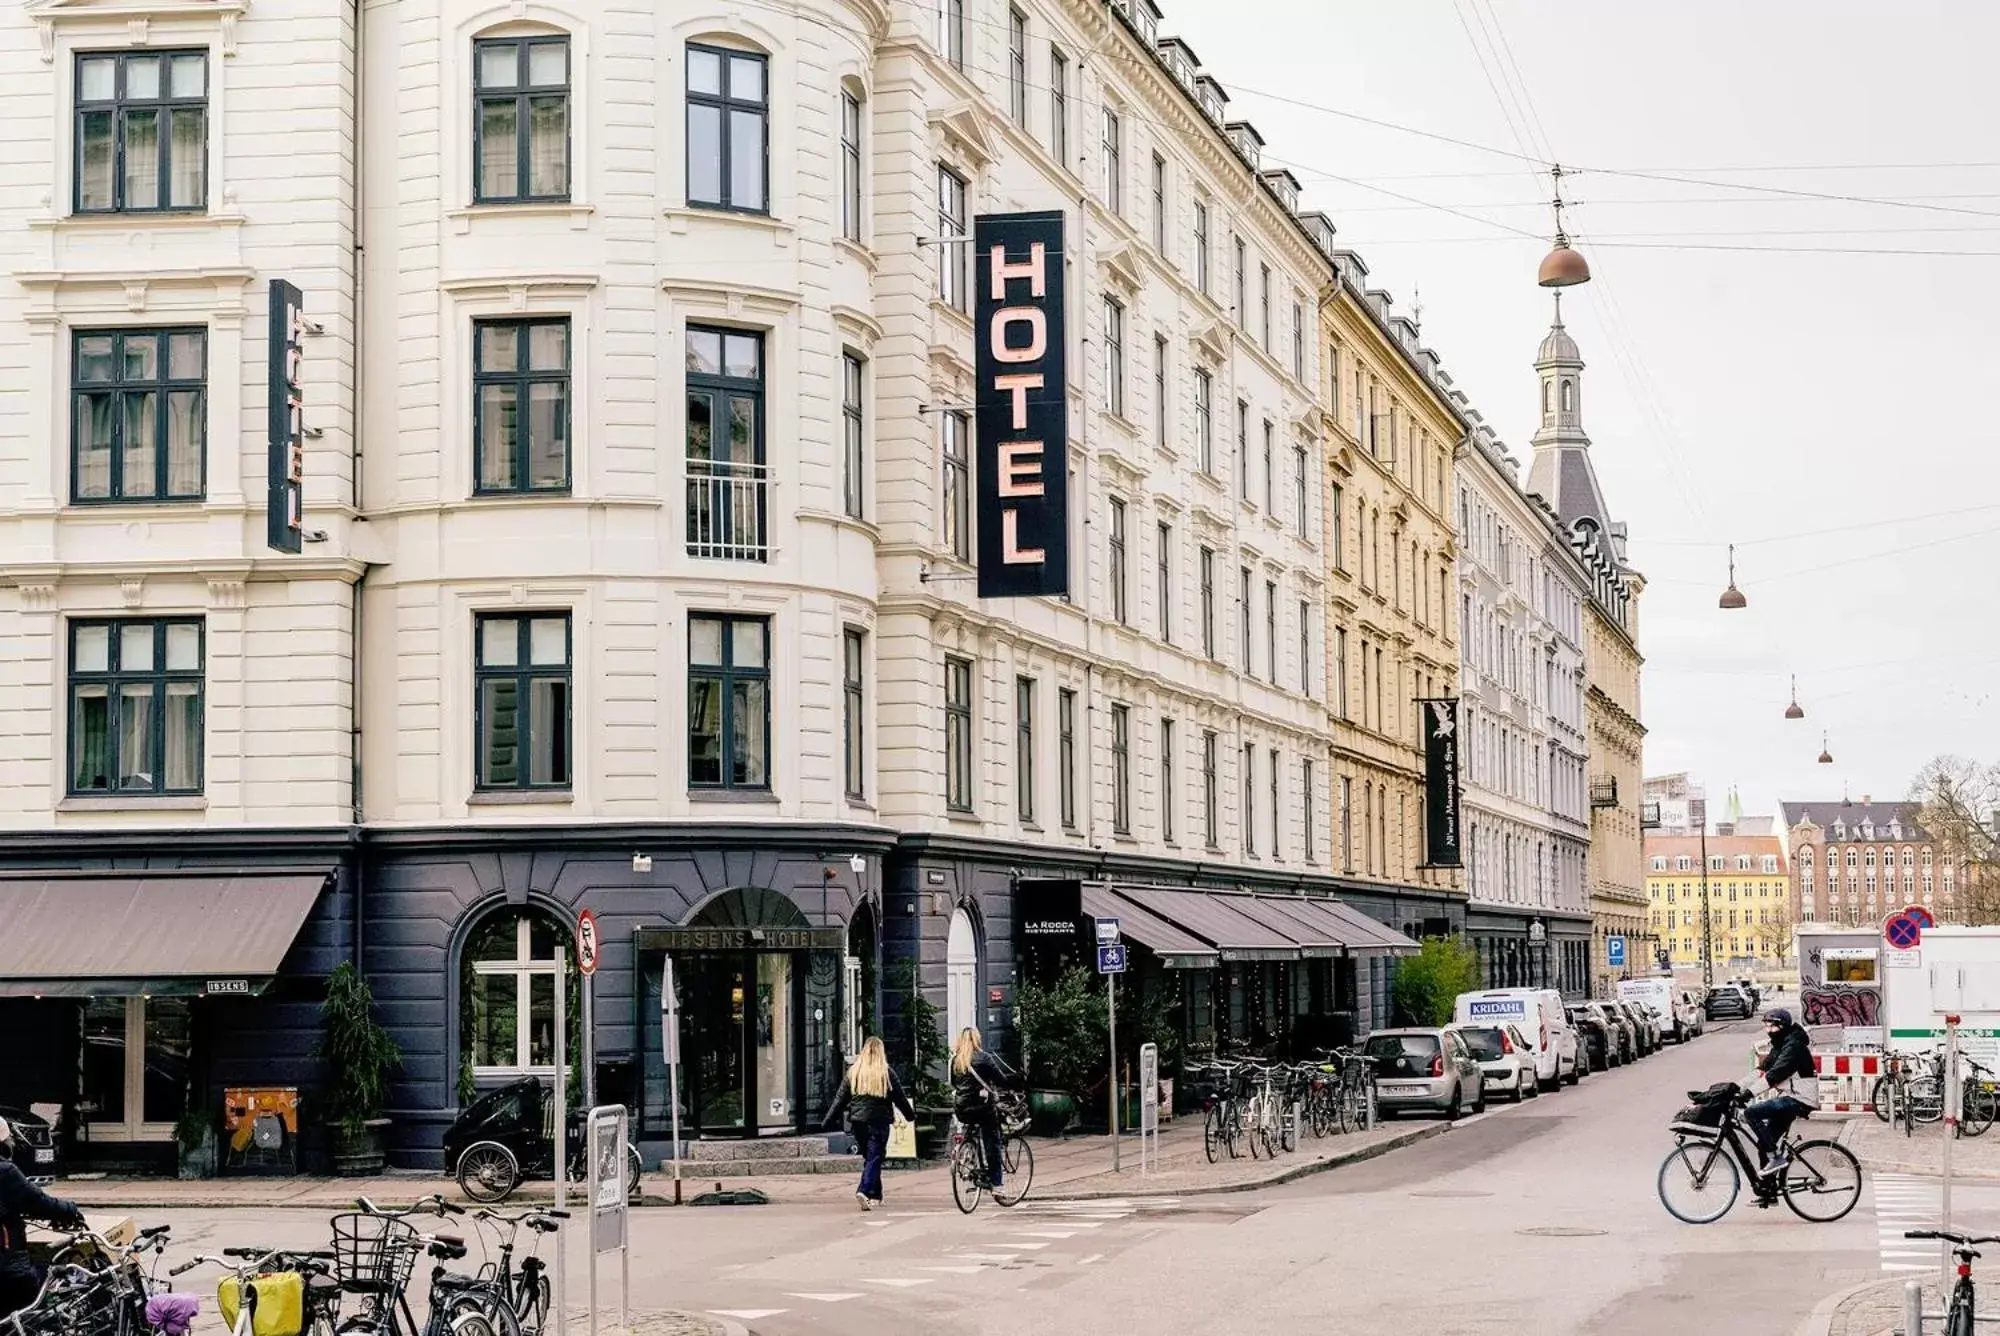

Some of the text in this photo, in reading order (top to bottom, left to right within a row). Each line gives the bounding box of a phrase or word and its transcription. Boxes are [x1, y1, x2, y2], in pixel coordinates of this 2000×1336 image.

[991, 242, 1047, 565] HOTEL
[1445, 742, 1454, 762] Spa
[1024, 921, 1039, 929] LA
[671, 931, 817, 947] IBSENS HOTEL
[1611, 941, 1621, 955] P
[1473, 1003, 1522, 1014] KRIDAHL
